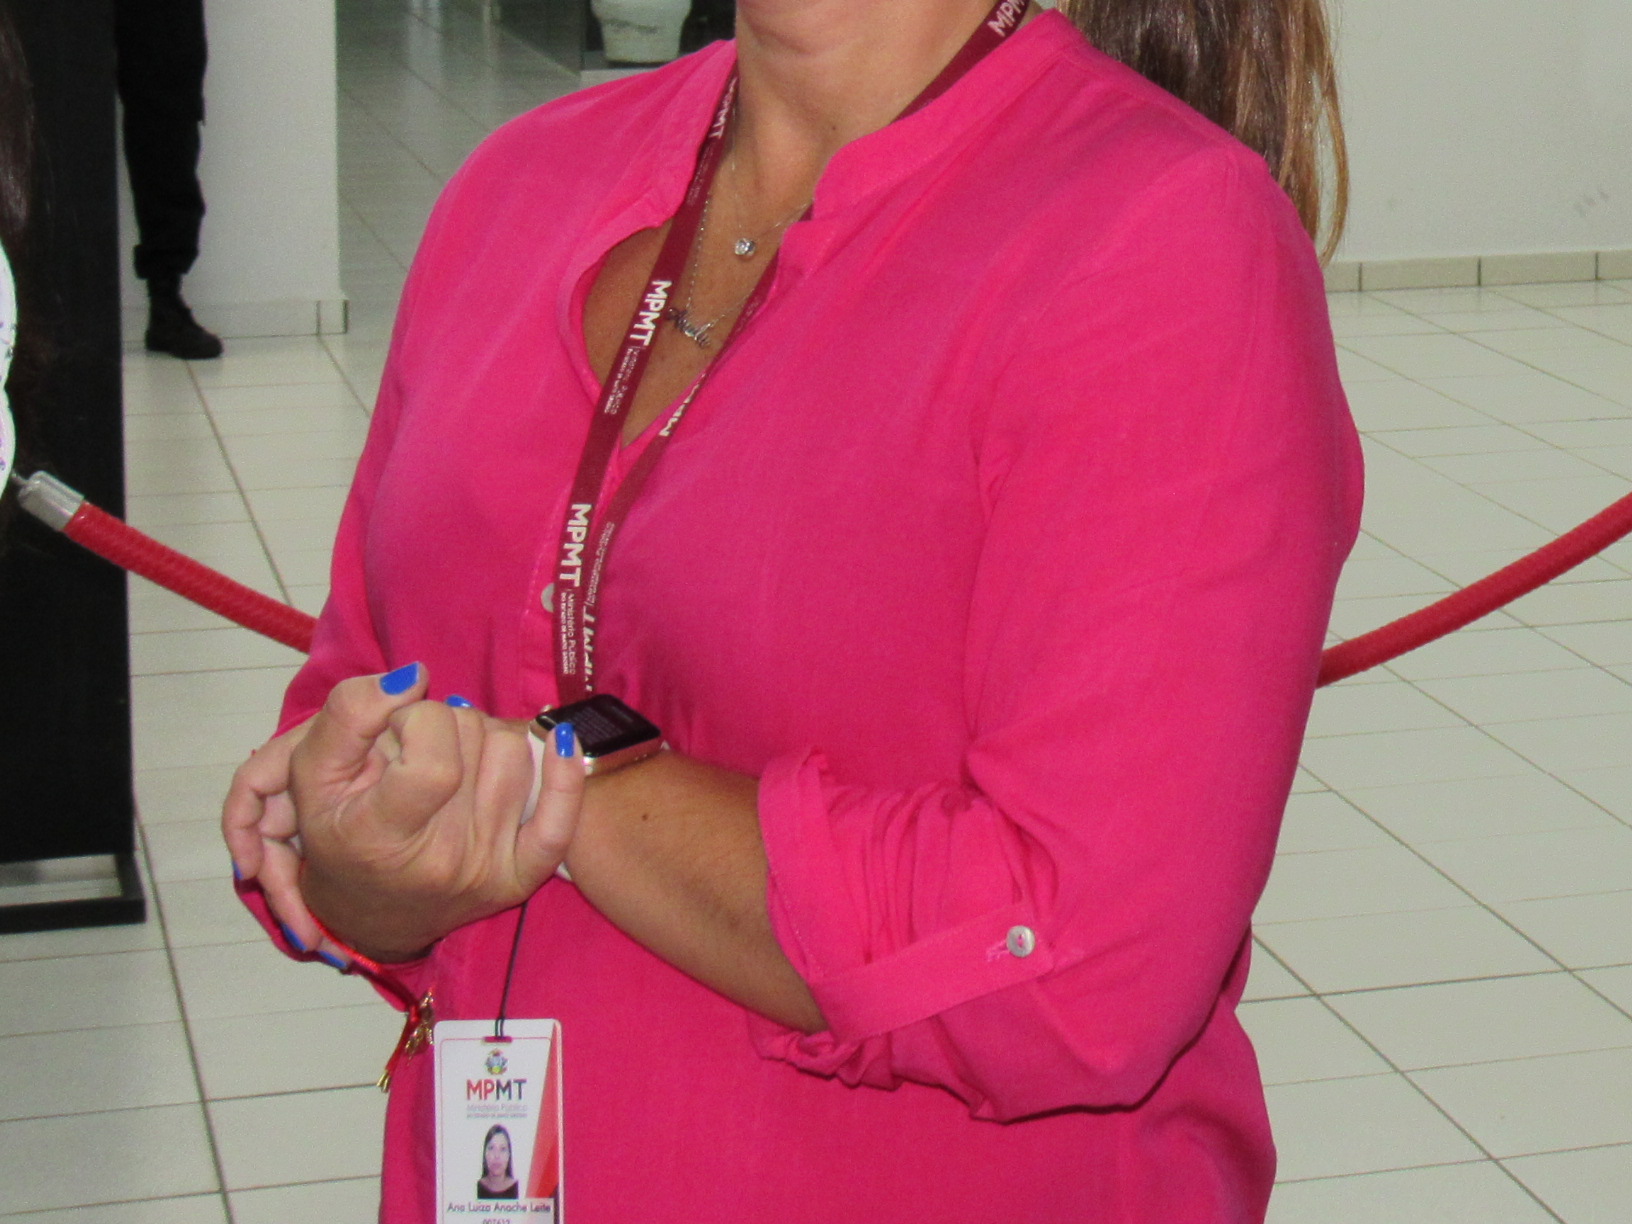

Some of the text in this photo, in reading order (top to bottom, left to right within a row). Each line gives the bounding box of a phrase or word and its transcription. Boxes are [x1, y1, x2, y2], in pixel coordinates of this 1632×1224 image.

[629, 279, 673, 347] MPMT
[559, 503, 593, 588] MPMT
[466, 1078, 528, 1101] MPMT
[447, 1202, 466, 1212] Ana
[494, 1201, 527, 1212] Anache
[530, 1202, 551, 1213] Leite
